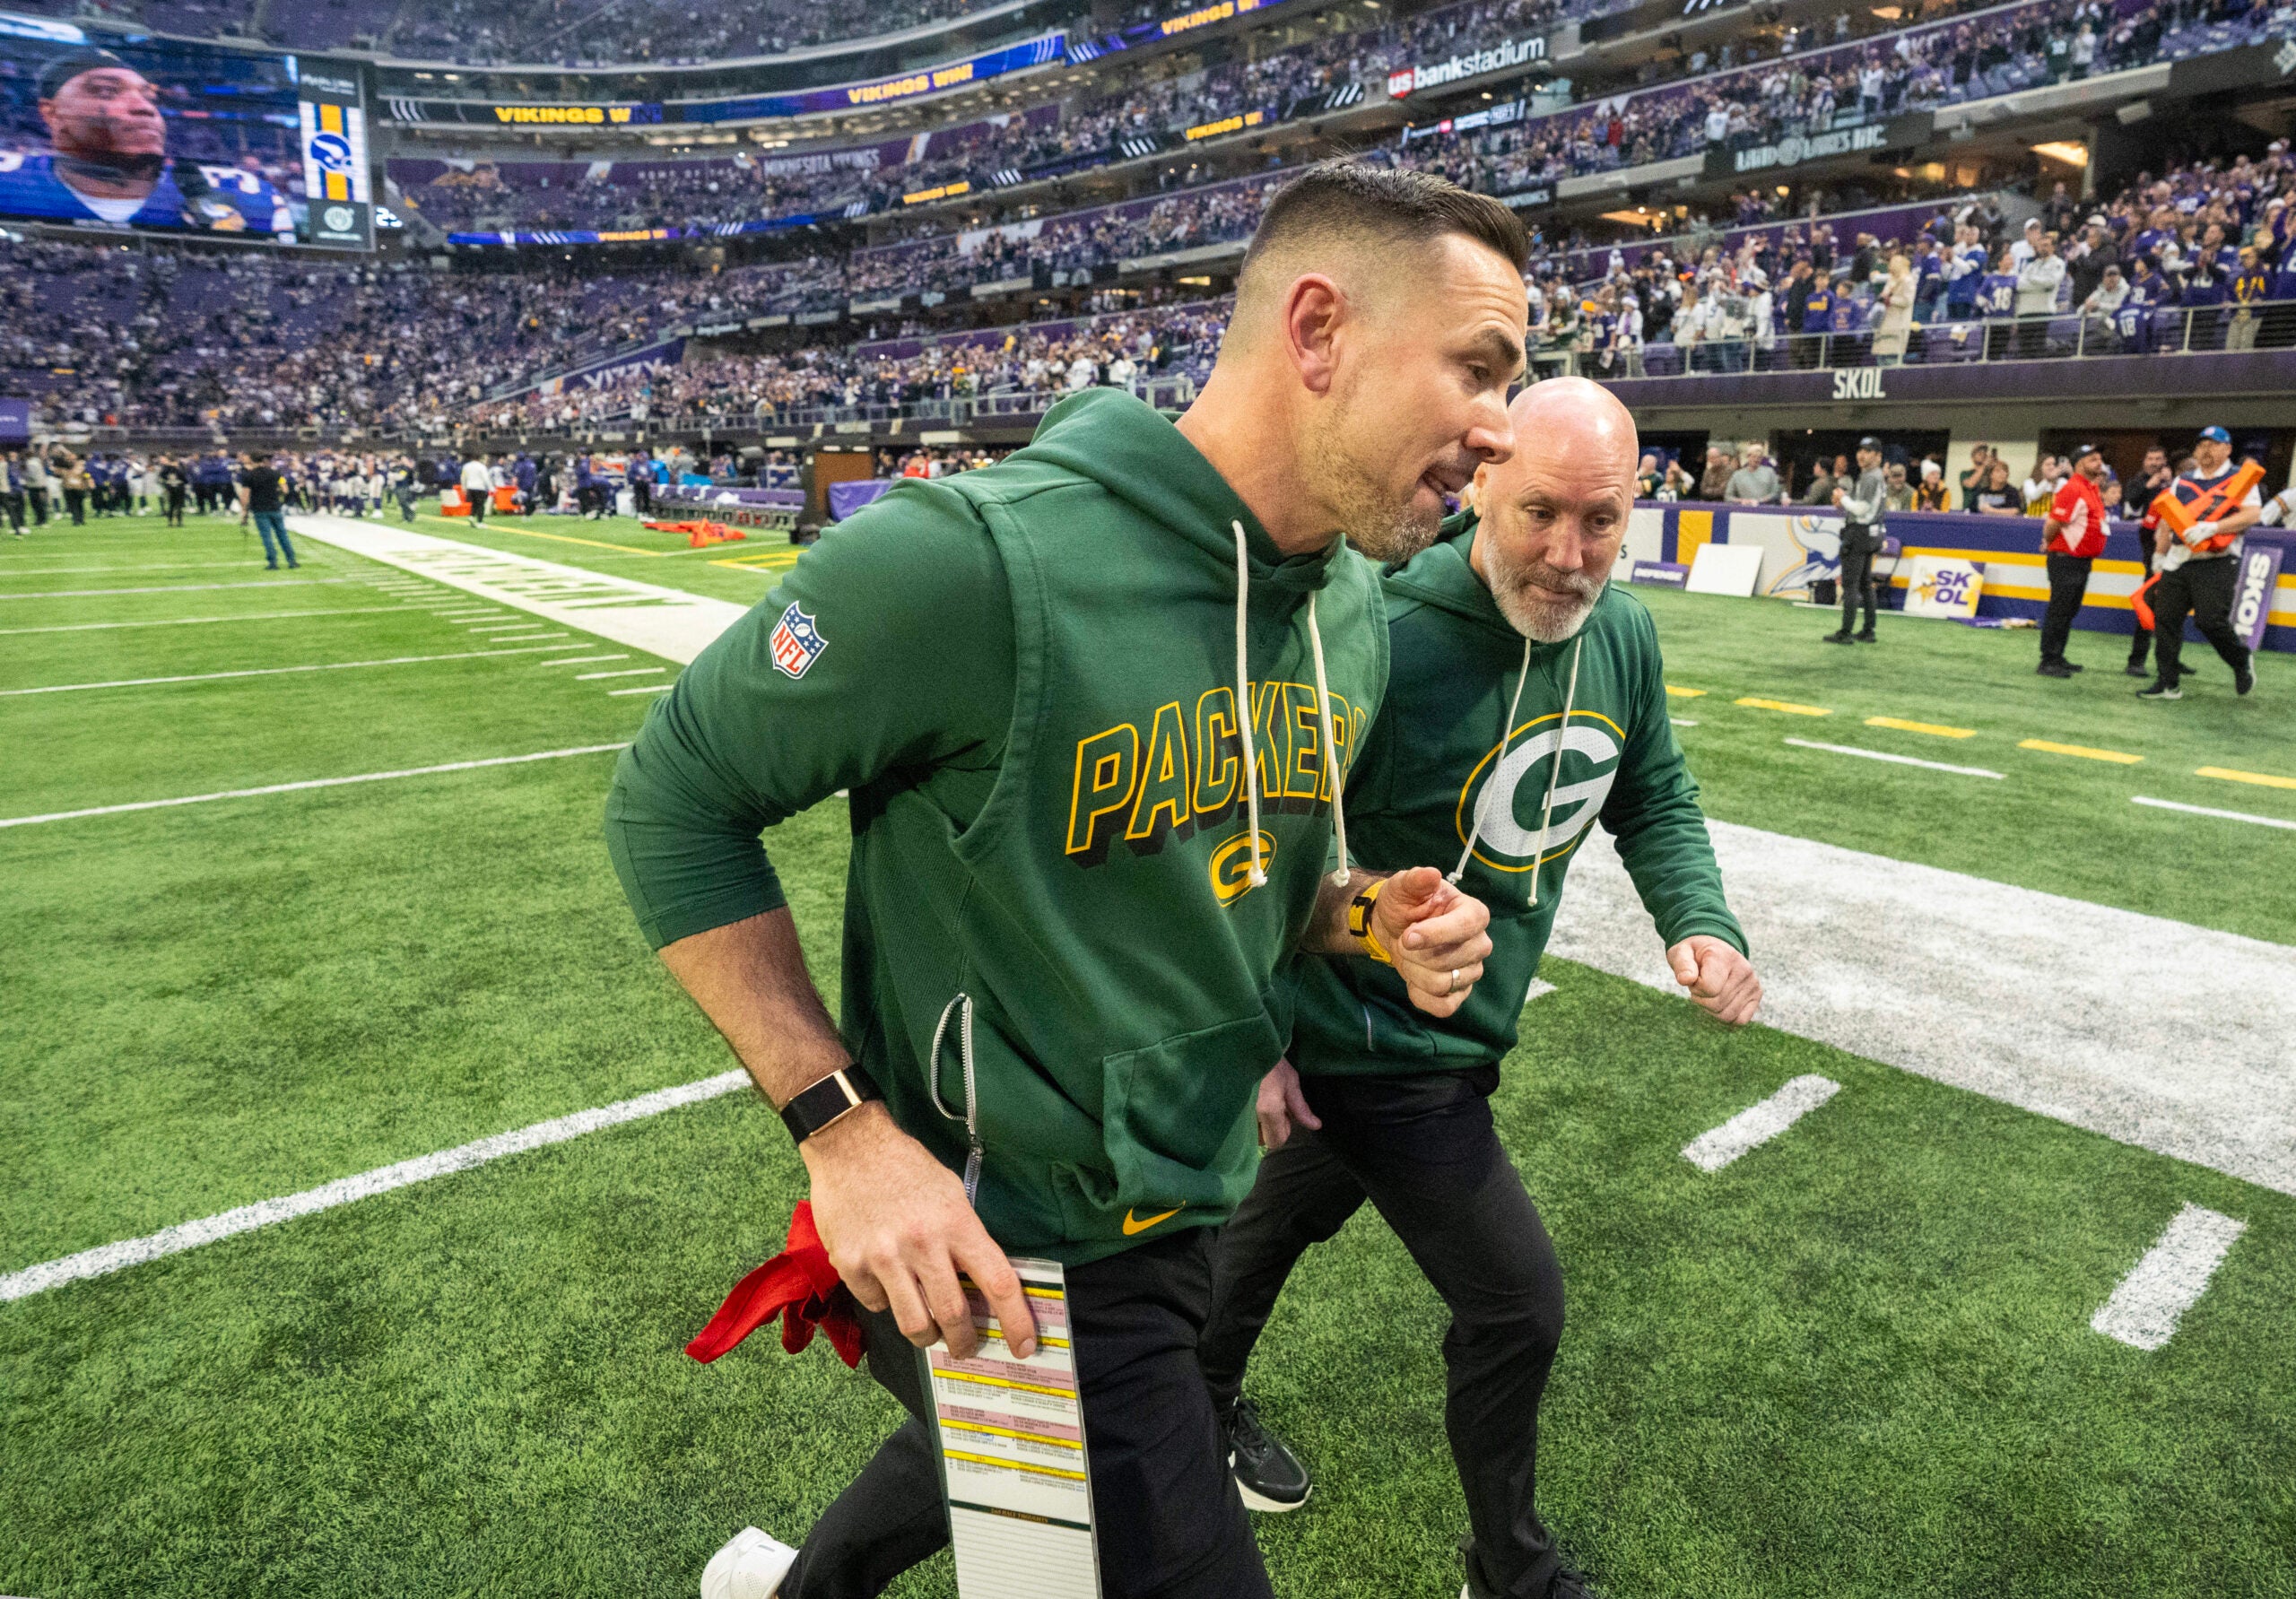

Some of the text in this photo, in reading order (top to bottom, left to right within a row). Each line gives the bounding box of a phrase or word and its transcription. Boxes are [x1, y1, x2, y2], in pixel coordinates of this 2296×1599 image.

[847, 74, 929, 103] VIKINGS
[494, 107, 604, 124] VIKINGS
[1832, 368, 1886, 399] SKOL
[1936, 569, 1971, 587] SK
[1935, 587, 1968, 605] OL
[773, 624, 804, 673] NFL
[1474, 726, 1619, 856] G
